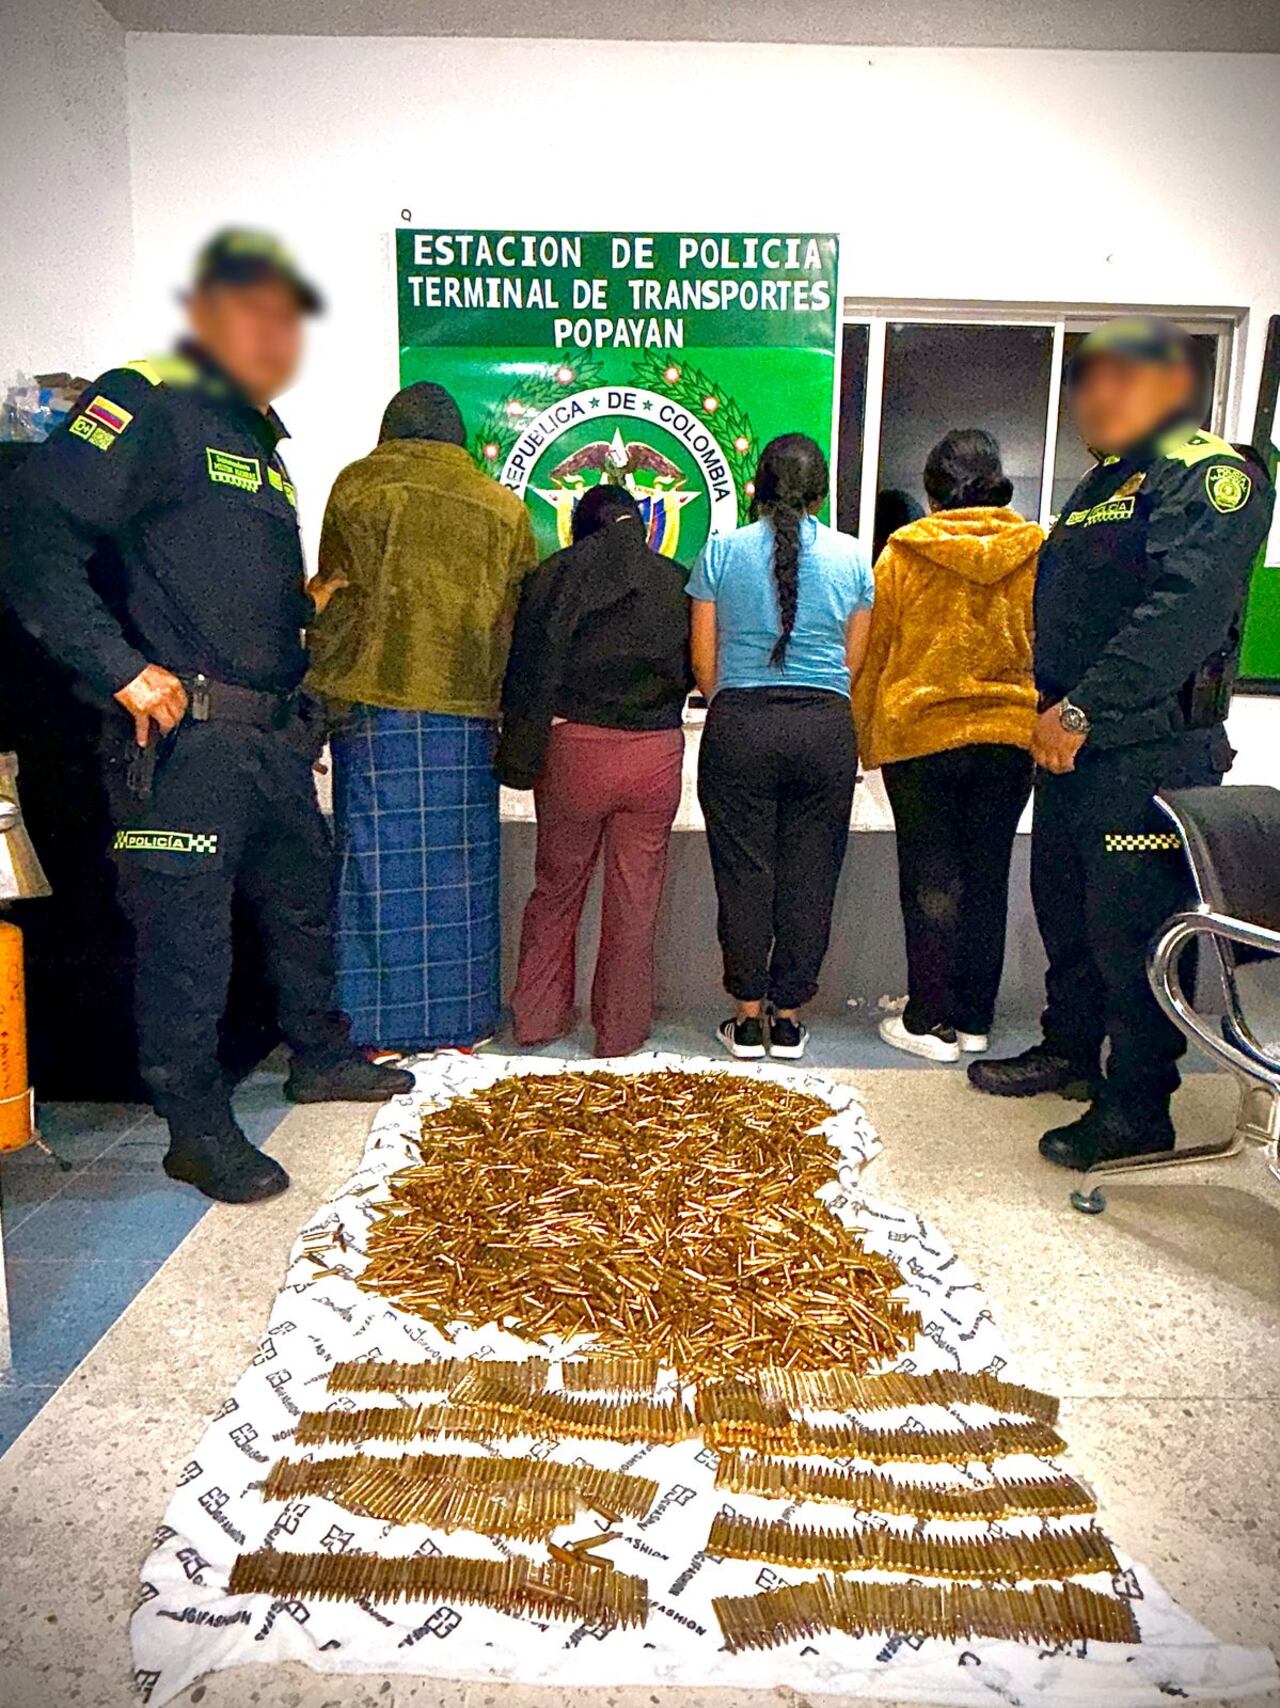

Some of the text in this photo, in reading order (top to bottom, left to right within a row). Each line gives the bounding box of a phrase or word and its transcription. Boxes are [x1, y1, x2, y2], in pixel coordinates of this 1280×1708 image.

[413, 234, 822, 270] ESTACION DE POLICIA
[408, 277, 830, 312] TERMINAL DE TRANSPORTES
[554, 318, 684, 348] POPAYAN
[607, 392, 637, 411] DE
[659, 405, 731, 503] COLOMBIA
[128, 835, 185, 849] POLICÍA
[649, 1599, 707, 1637] FASHION
